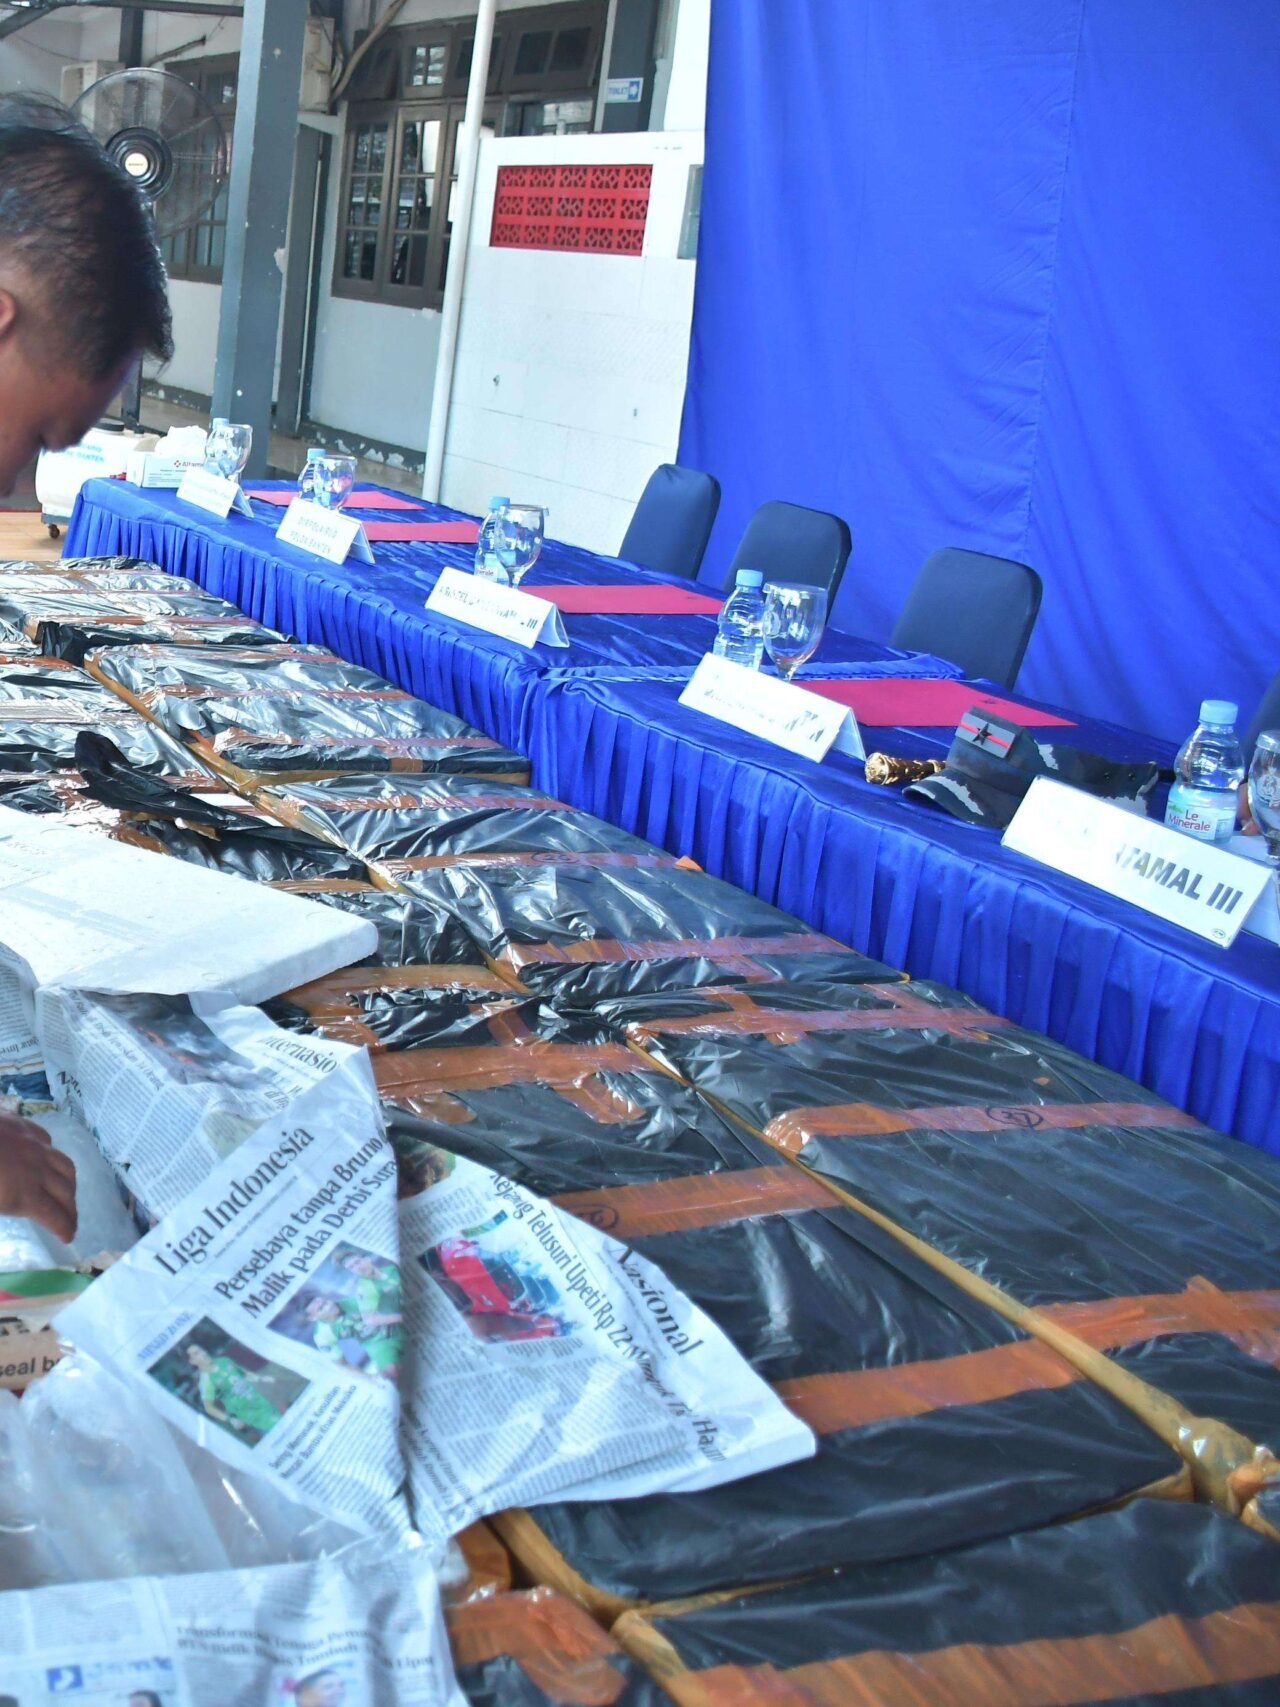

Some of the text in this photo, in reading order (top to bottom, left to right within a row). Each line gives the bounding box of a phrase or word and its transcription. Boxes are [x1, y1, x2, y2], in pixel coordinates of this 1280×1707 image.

[1169, 813, 1211, 832] Minerale
[1185, 808, 1199, 821] Le
[1206, 882, 1243, 915] III
[153, 1224, 215, 1276] Liga
[202, 1127, 315, 1231] Indonesia
[214, 1223, 300, 1300] Persebaya
[291, 1178, 342, 1226] tanpa
[333, 1137, 384, 1184] Bruno
[240, 1270, 296, 1319] Malik
[289, 1227, 334, 1275] pada
[322, 1185, 373, 1230] Derbi
[526, 1208, 578, 1271] Telusuri
[565, 1258, 606, 1312] Upeti
[592, 1301, 615, 1332] Rp
[608, 1323, 634, 1350] 22
[612, 1247, 704, 1357] Nasional
